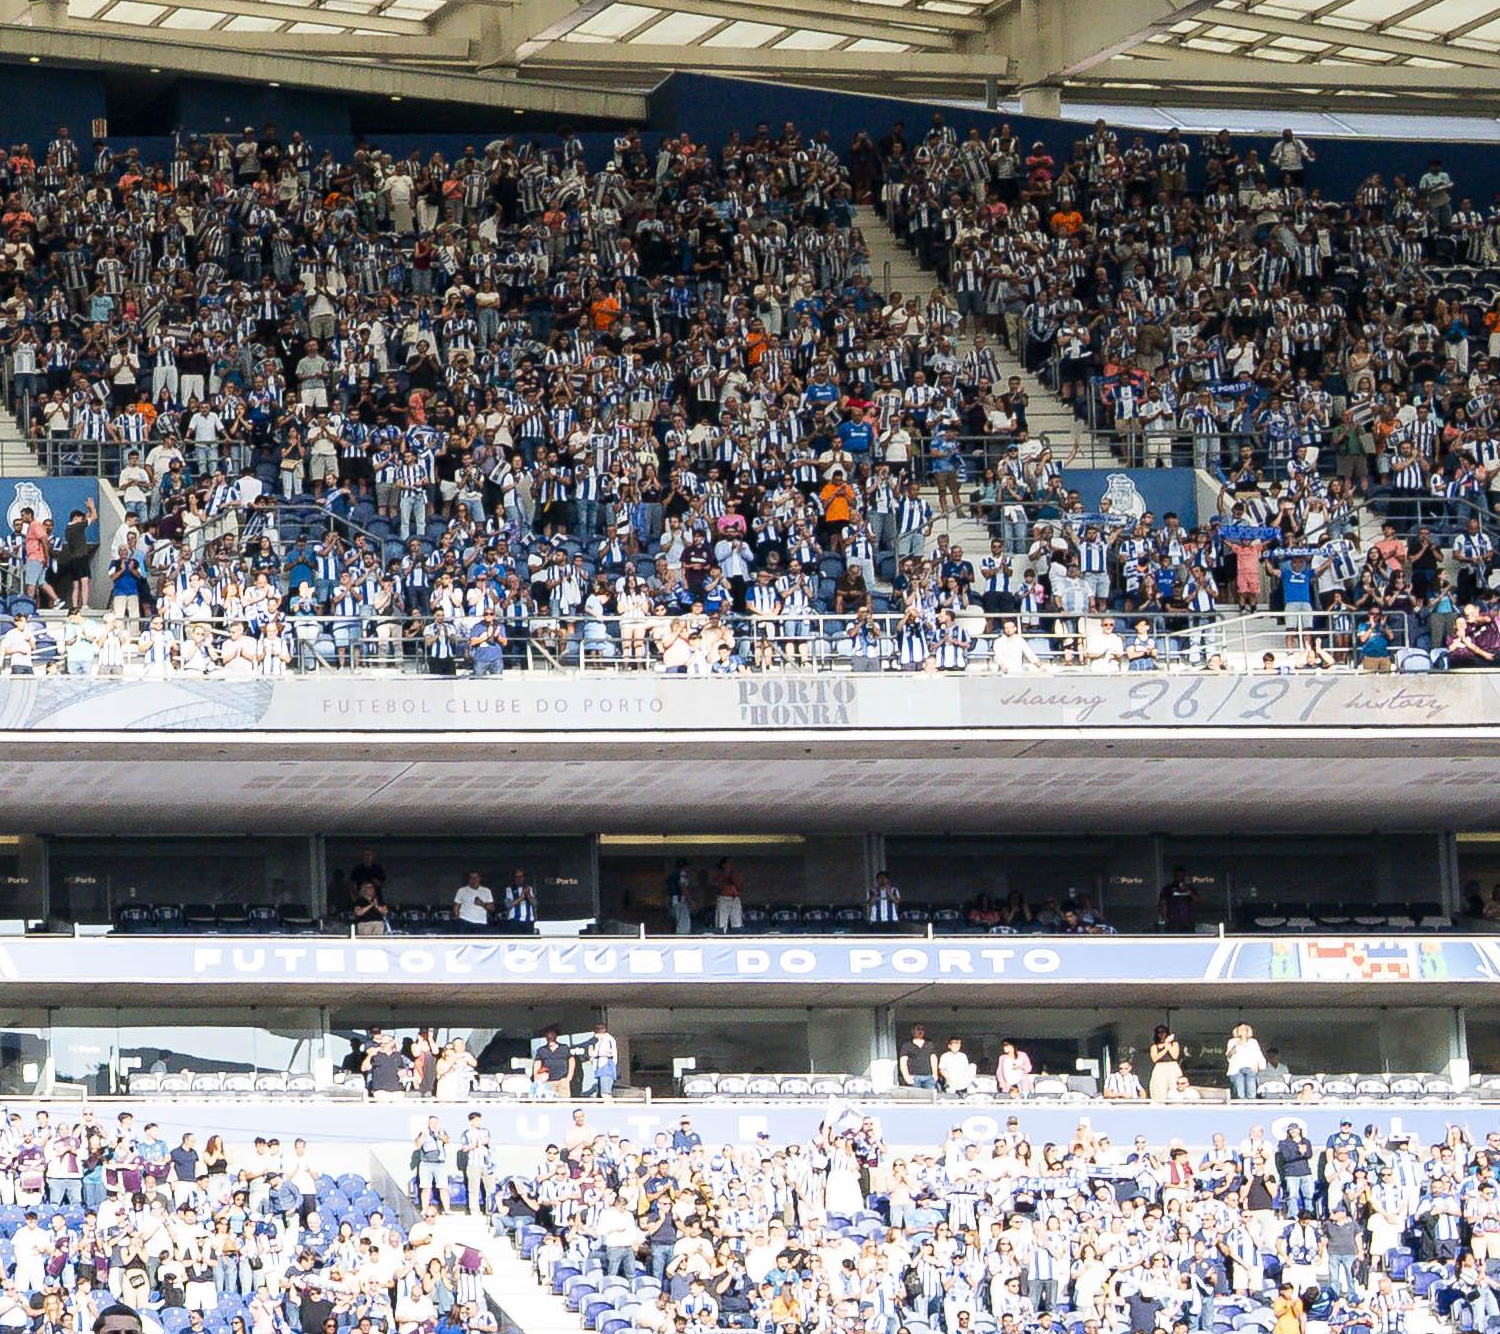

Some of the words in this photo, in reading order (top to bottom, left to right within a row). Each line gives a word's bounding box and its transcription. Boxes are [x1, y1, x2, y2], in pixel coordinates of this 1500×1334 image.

[738, 680, 856, 705] PORTO
[1000, 685, 1106, 720] sharing
[1118, 677, 1339, 719] 26/27
[323, 698, 430, 714] FUTEBOL
[445, 698, 521, 714] CLUBE
[536, 698, 569, 714] DO
[583, 698, 664, 714] PORTO
[750, 705, 849, 725] HONRA
[193, 947, 473, 974] FUTEBOL
[502, 948, 704, 975] CLUBE
[735, 949, 818, 975] DO
[848, 948, 1063, 974] PORTO
